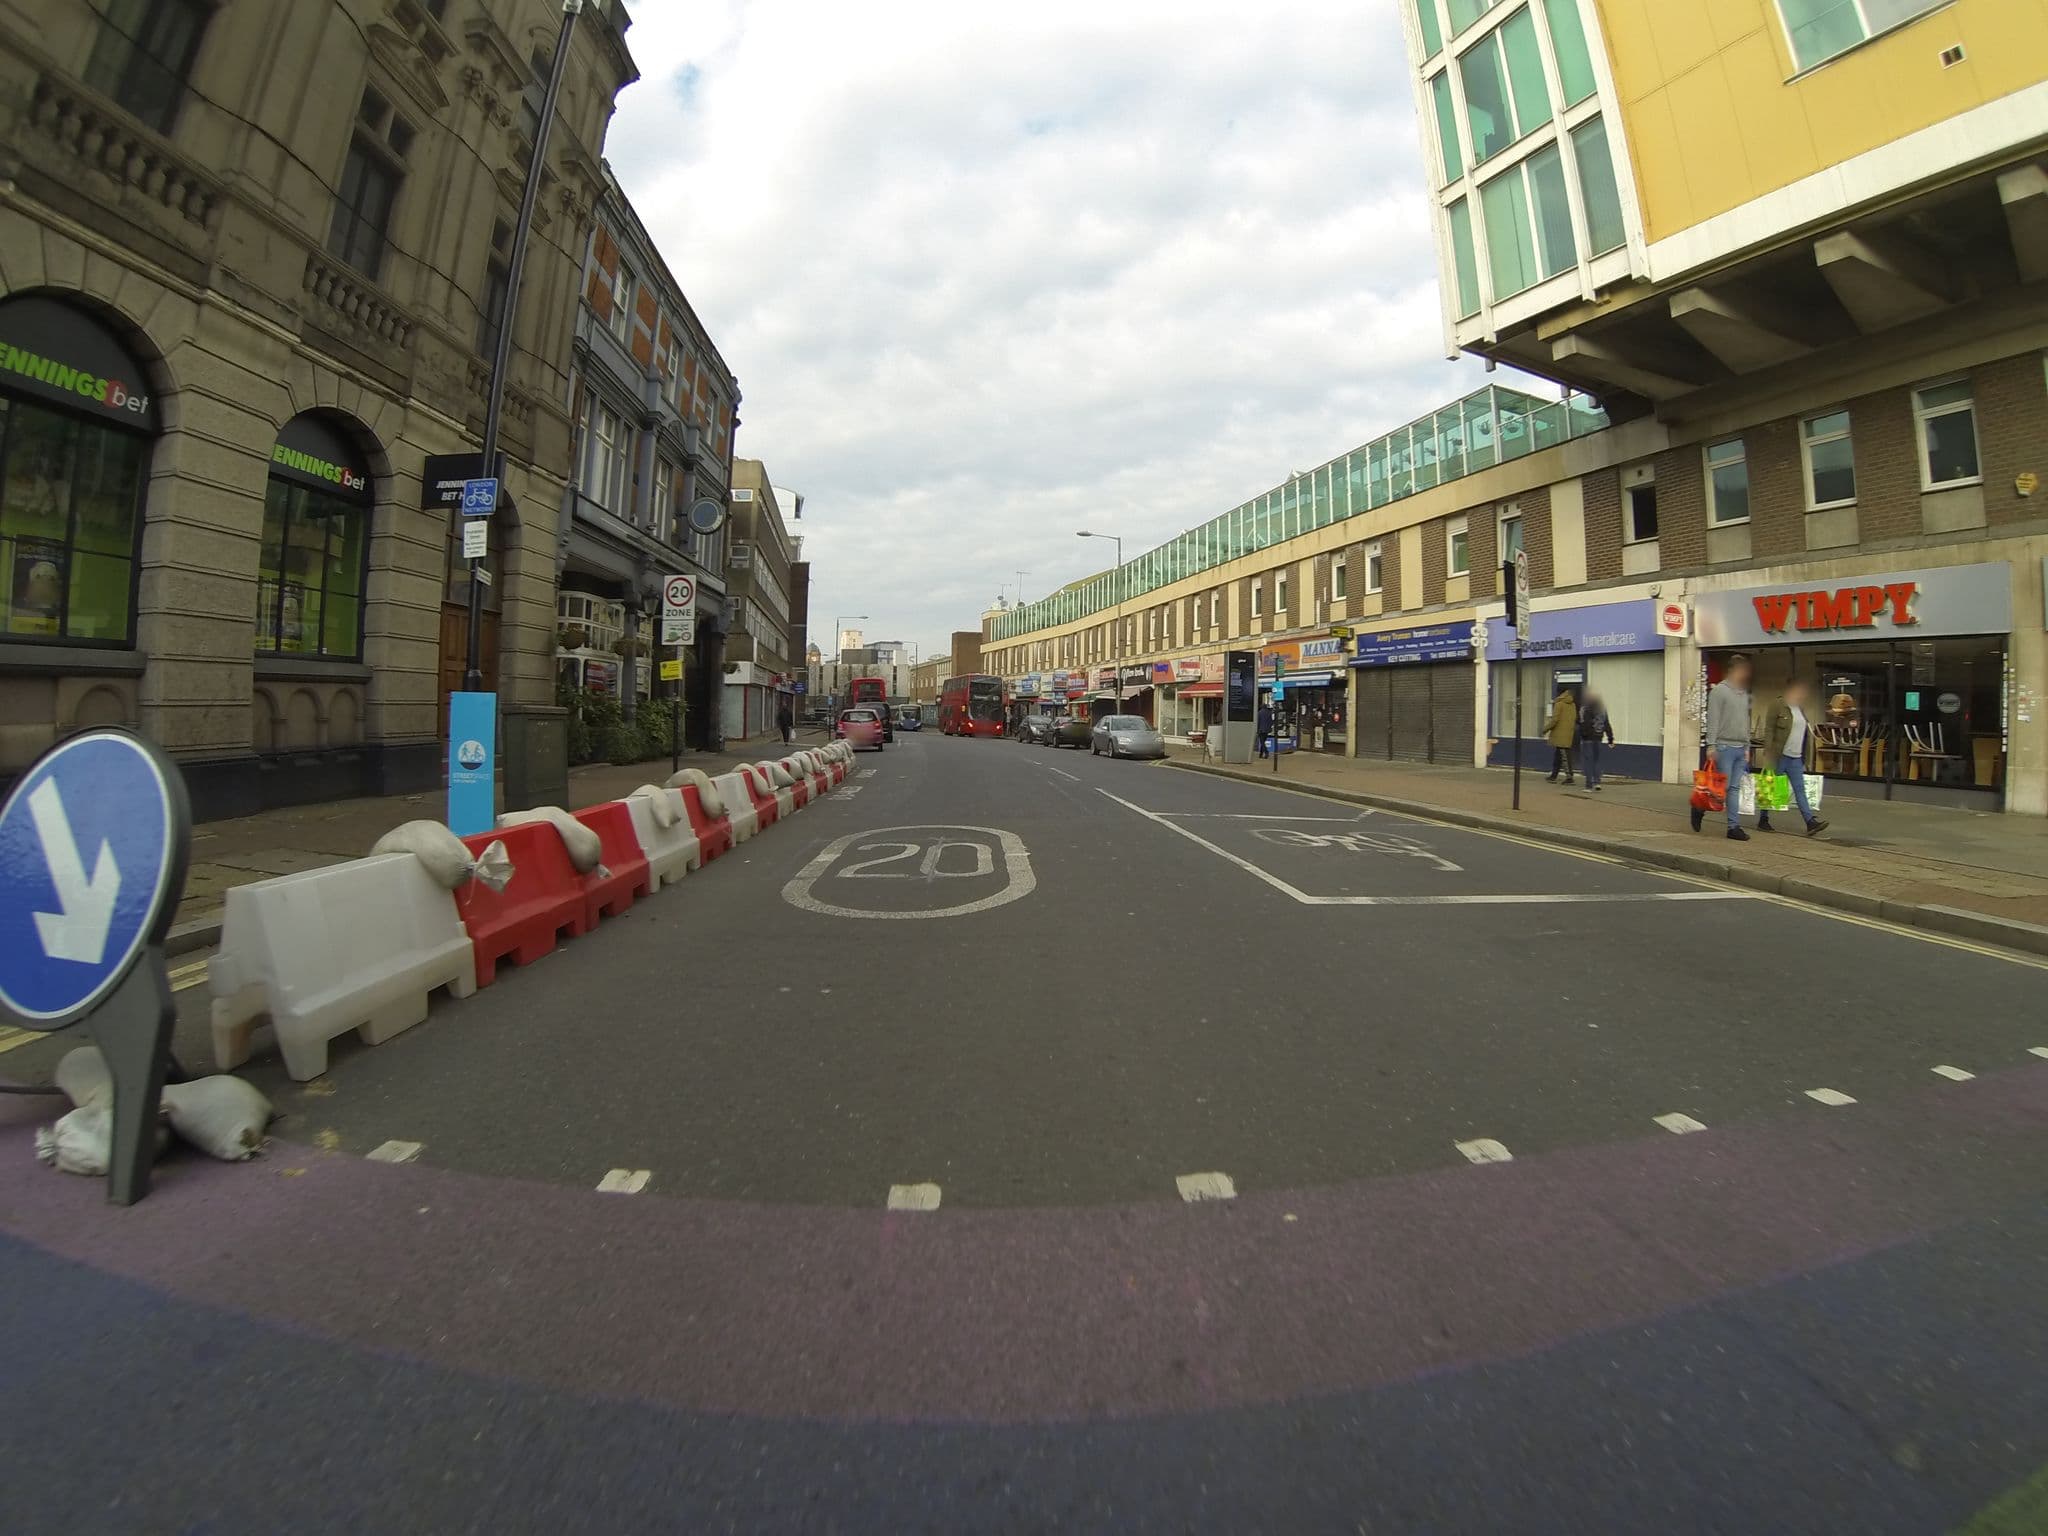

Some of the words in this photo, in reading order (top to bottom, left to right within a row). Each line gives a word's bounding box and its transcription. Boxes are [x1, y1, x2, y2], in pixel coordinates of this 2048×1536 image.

[0, 342, 109, 402] ENNINGS
[272, 443, 342, 484] ENNINGS
[436, 480, 465, 489] JENNIN
[670, 586, 690, 598] 20
[666, 609, 692, 617] ZONE
[1752, 582, 1917, 633] WIMPY
[1303, 640, 1342, 656] MANNA
[1521, 637, 1572, 655] o-operative
[1582, 633, 1635, 650] funeralcare
[836, 842, 994, 878] 20
